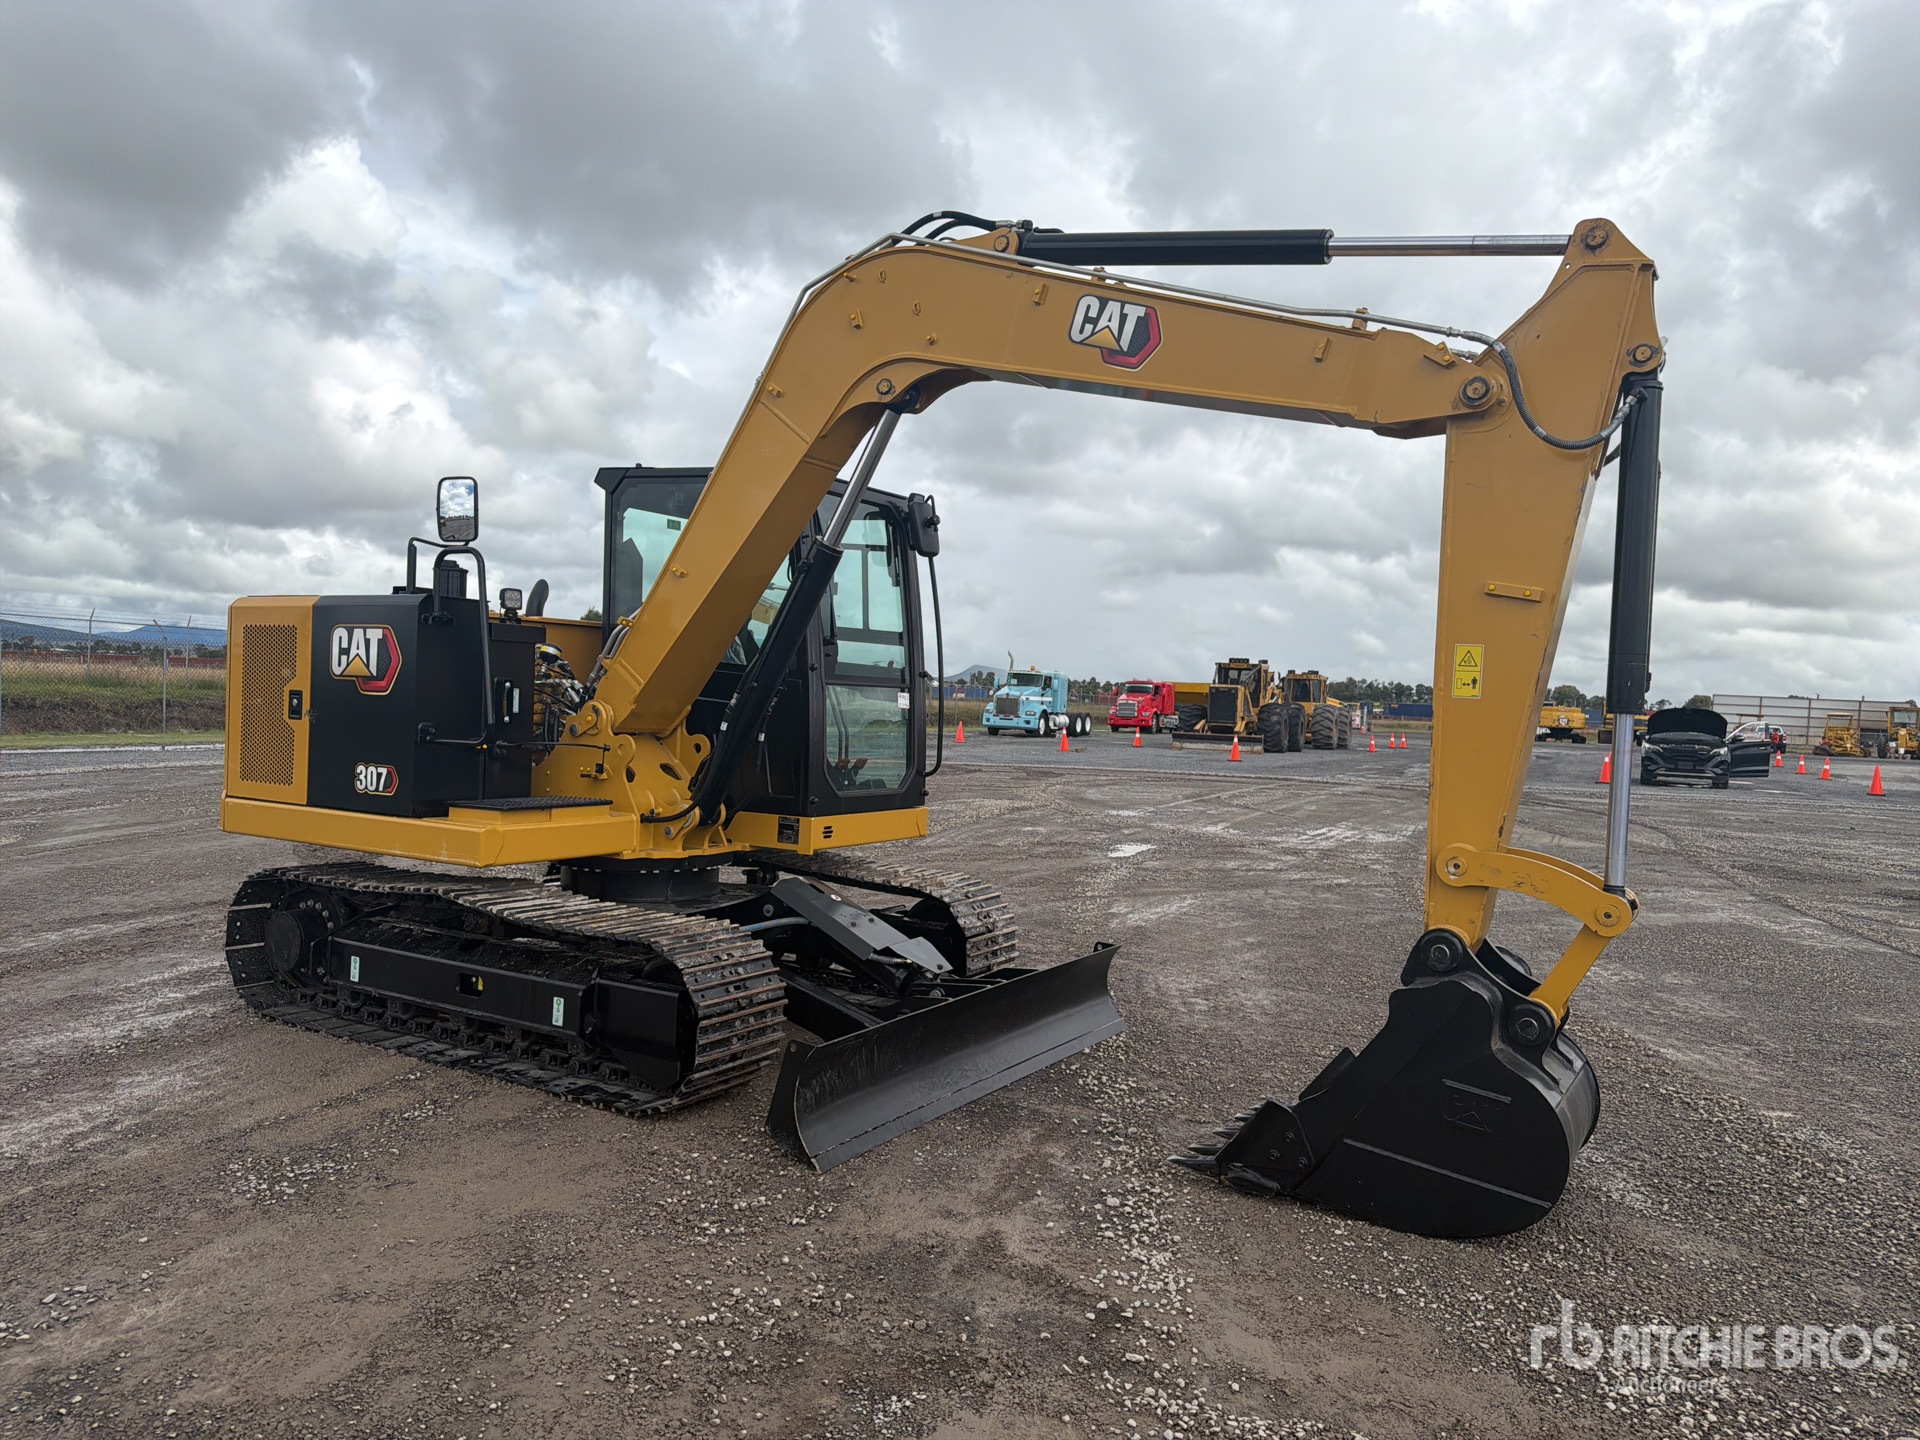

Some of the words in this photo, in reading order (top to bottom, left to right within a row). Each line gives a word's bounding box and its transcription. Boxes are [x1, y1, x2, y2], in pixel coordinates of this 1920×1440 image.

[1070, 295, 1147, 352] CAT
[332, 627, 383, 677] CAT
[356, 764, 388, 792] 307
